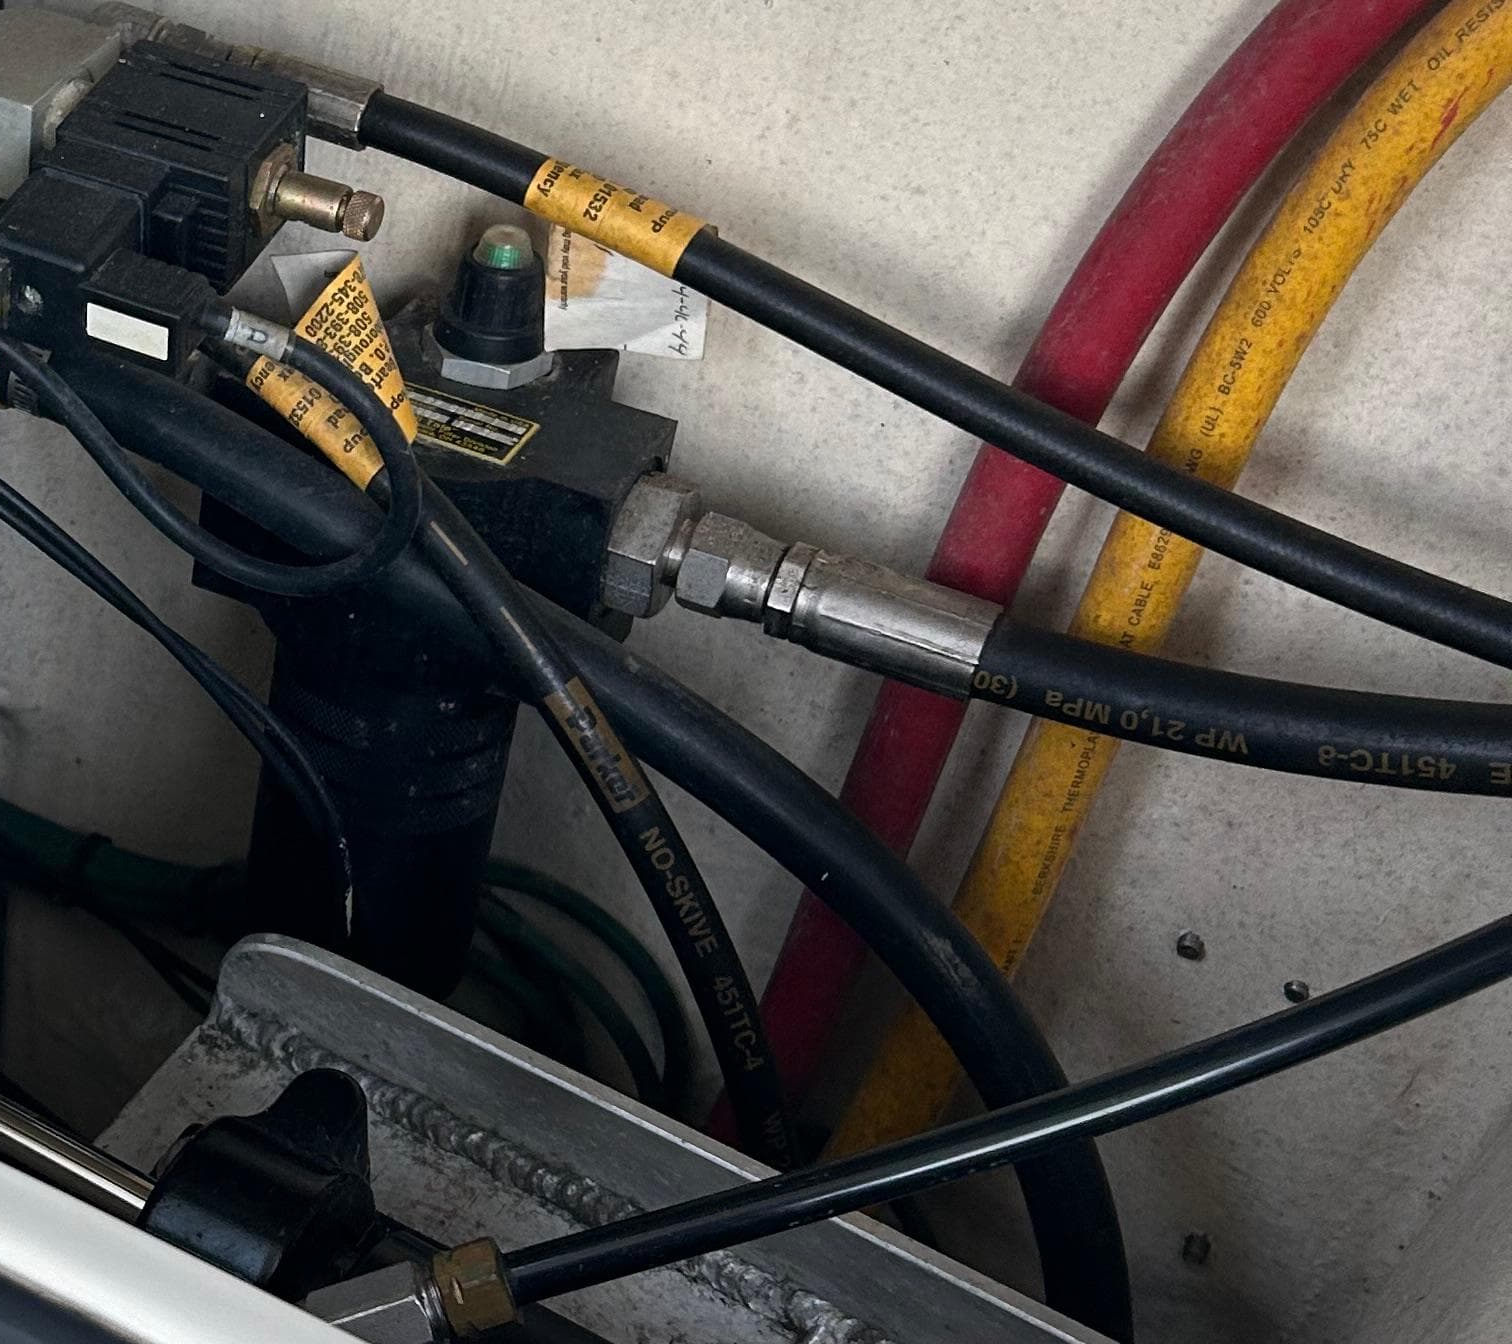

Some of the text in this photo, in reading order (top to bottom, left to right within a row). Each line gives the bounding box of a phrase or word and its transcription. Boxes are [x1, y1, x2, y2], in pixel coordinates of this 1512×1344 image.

[1199, 406, 1224, 438] (UL)
[1250, 300, 1273, 329] 600
[1386, 78, 1421, 117] WET
[1426, 46, 1454, 72] OIL
[1127, 581, 1155, 629] CABLE
[1044, 689, 1113, 725] MPa
[1118, 704, 1188, 742] 21,0
[1194, 726, 1249, 755] WP
[566, 705, 638, 806] Parker
[638, 824, 720, 958] NO-SKIVE
[712, 973, 765, 1073] 451TC-4
